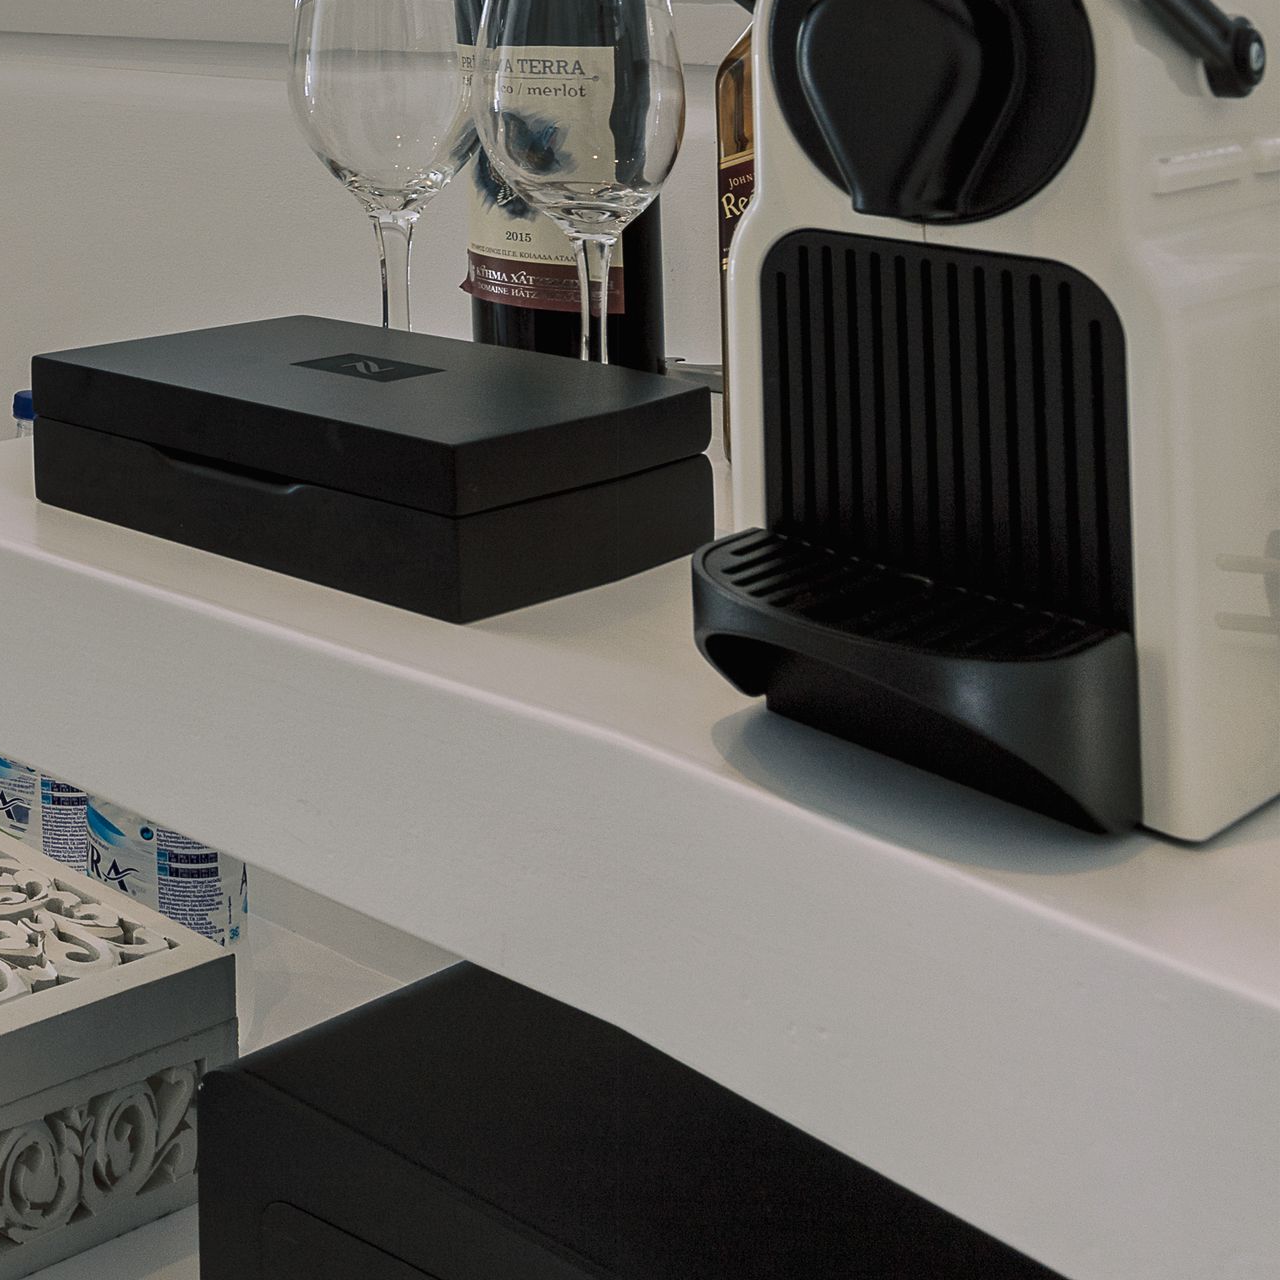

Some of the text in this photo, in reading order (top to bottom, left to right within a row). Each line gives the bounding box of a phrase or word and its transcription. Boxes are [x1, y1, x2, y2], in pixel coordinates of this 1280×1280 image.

[517, 59, 586, 75] TERRA
[527, 84, 587, 98] merlot
[505, 231, 532, 242] 2015
